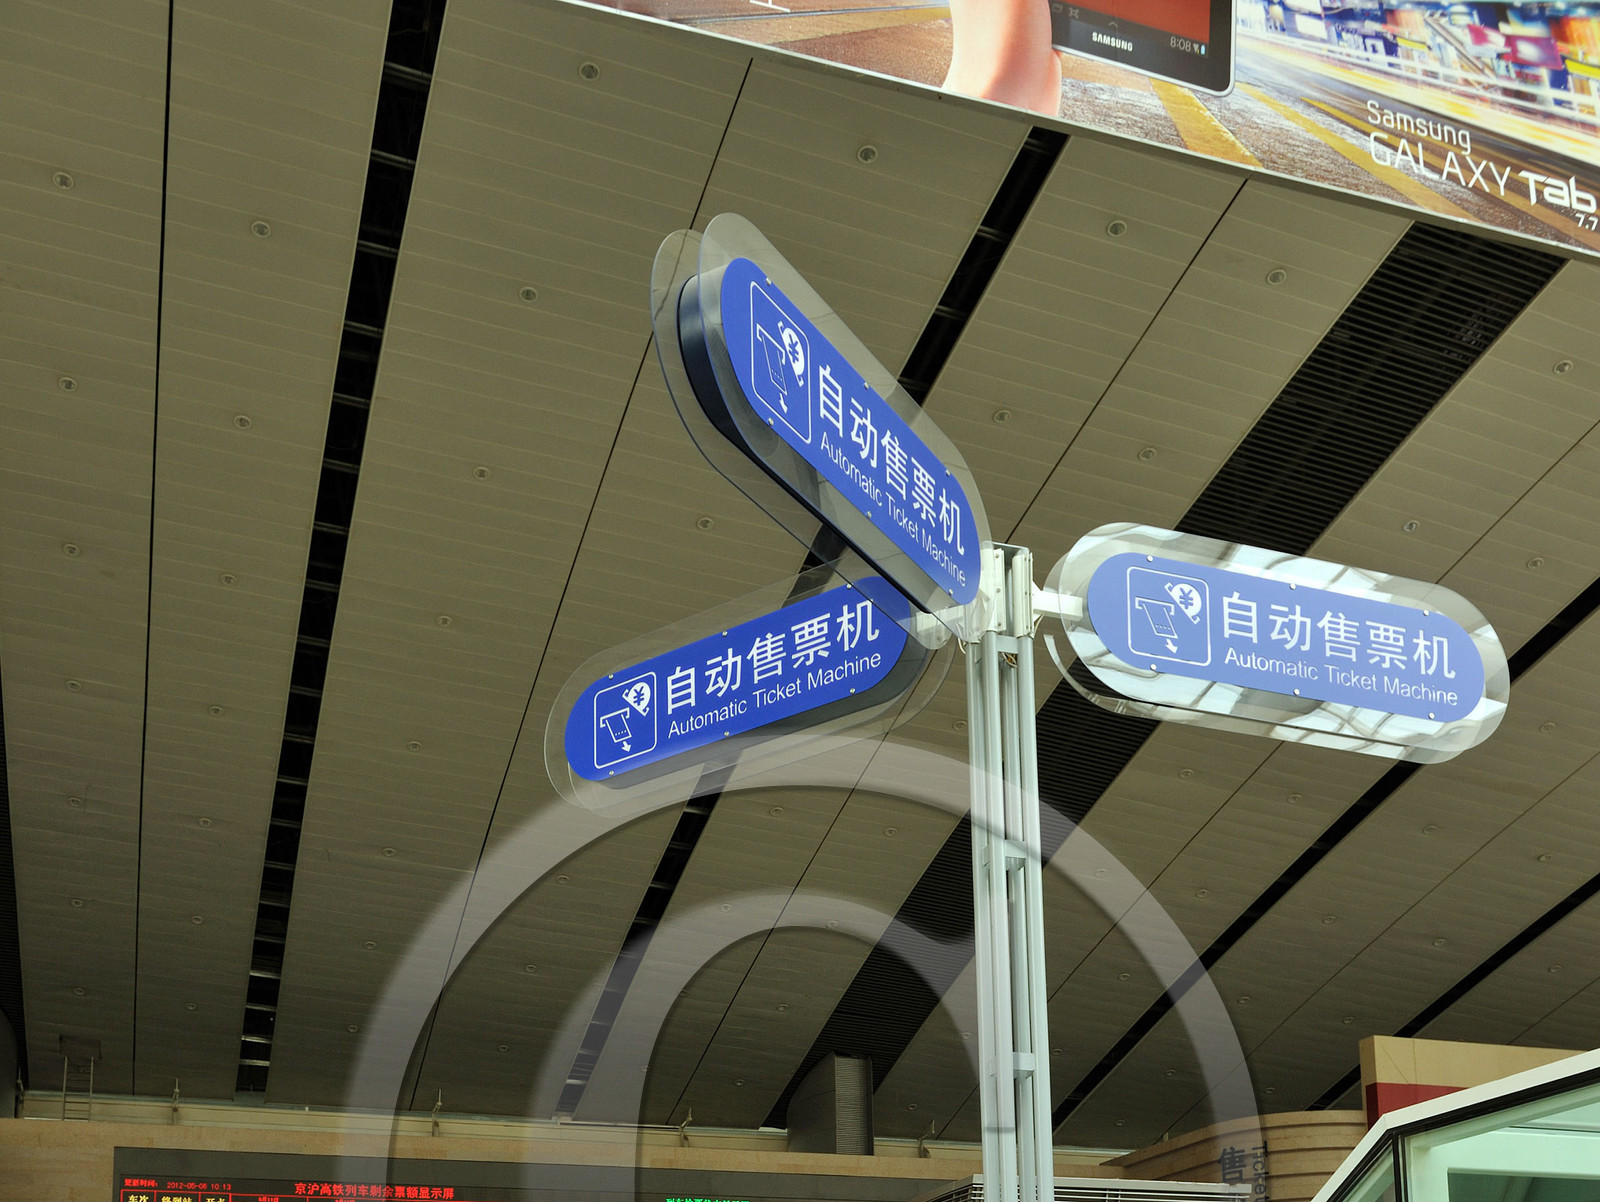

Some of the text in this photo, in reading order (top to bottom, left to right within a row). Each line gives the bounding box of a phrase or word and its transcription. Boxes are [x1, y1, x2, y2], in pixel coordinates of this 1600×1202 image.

[1092, 31, 1133, 52] SAMSUNG
[1170, 36, 1191, 51] 8:08
[1367, 99, 1471, 155] Samsung
[1370, 131, 1598, 214] GALAXY Tab
[1575, 212, 1599, 231] 7.7
[818, 364, 965, 556] 自动售票机
[820, 431, 966, 588] Automatic Ticket Machine
[666, 598, 880, 715] 自动售票机
[1222, 590, 1456, 681] 自动售票机
[668, 652, 882, 739] Automatic Ticket Machine
[1224, 647, 1459, 707] Automatic Ticket Machine
[294, 1182, 454, 1200] 京沪高铁列车剩余票额显示屏
[1252, 1140, 1270, 1202] Ticket
